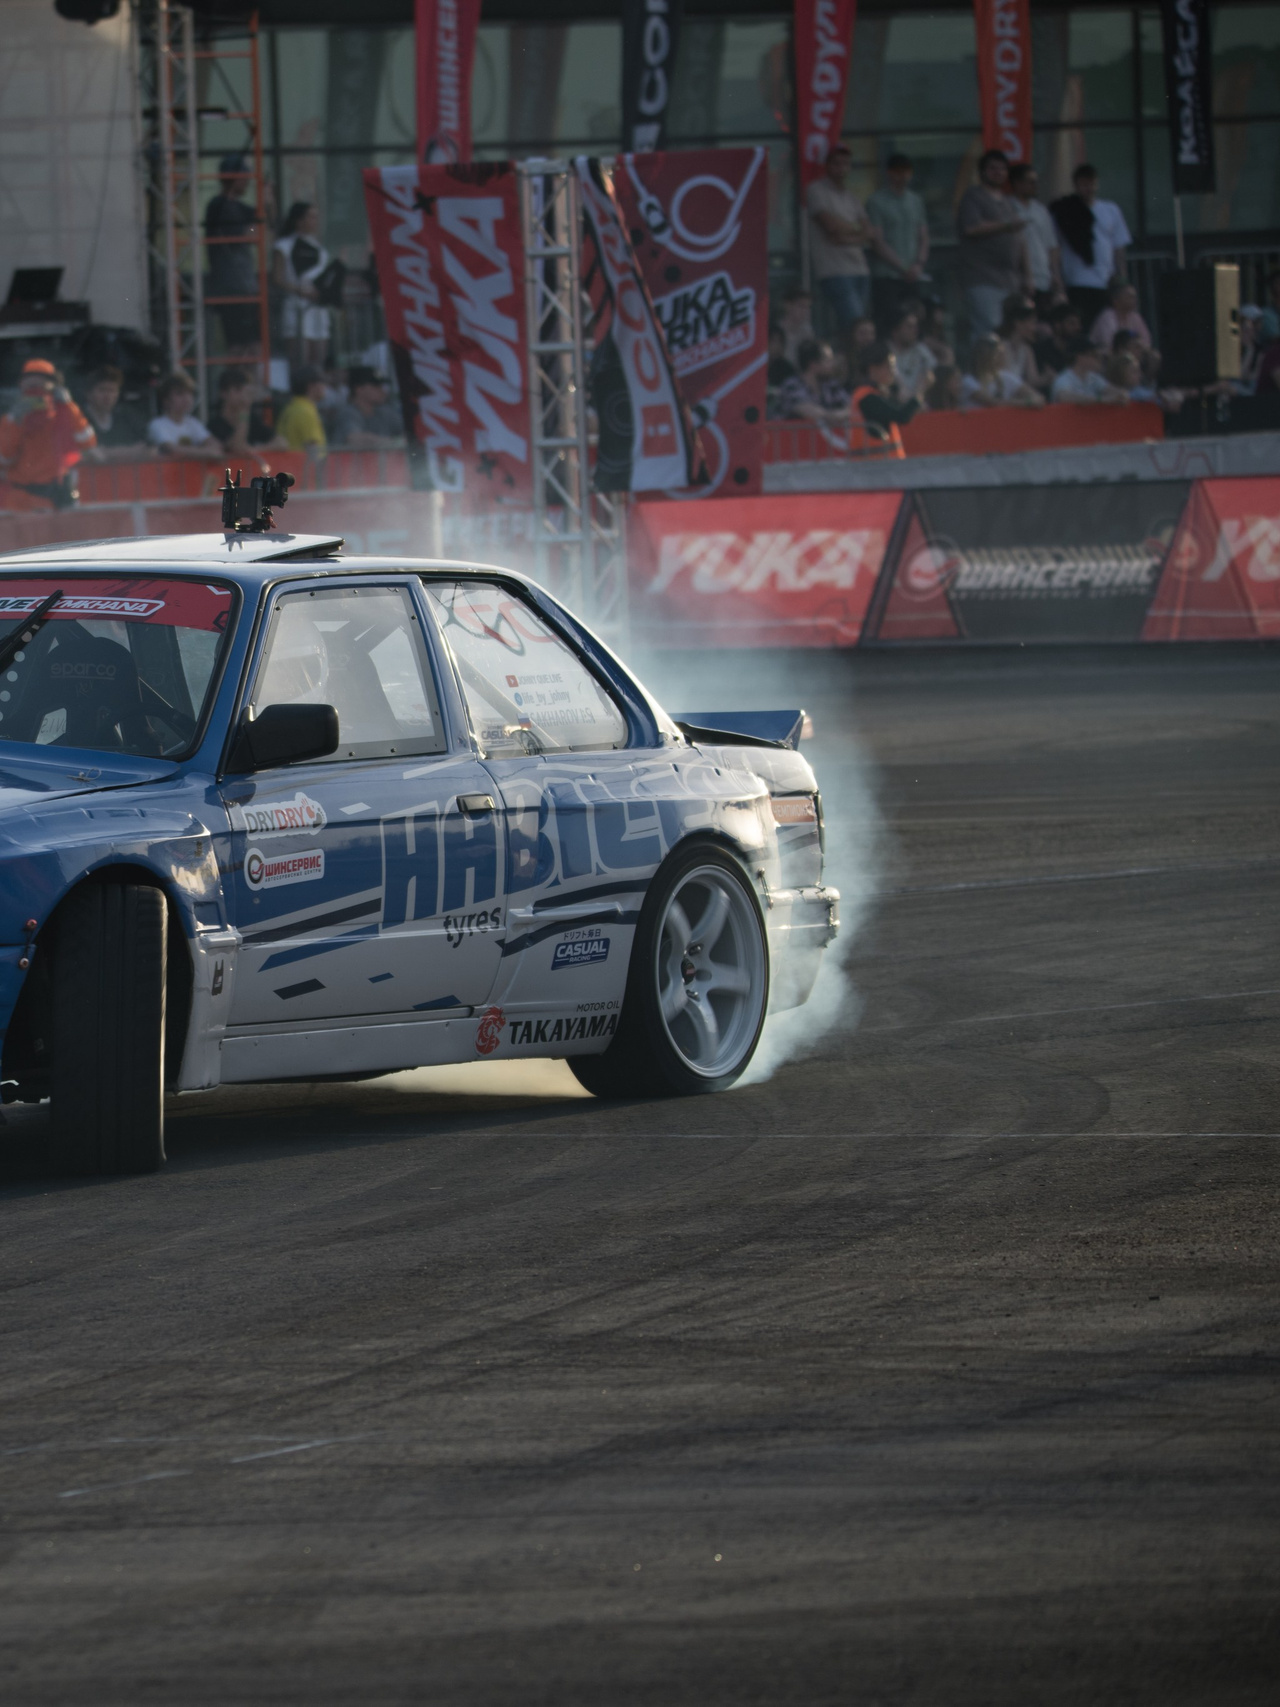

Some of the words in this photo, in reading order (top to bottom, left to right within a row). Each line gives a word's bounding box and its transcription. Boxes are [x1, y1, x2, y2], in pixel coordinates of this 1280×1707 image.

[653, 277, 733, 328] UKA
[381, 166, 465, 493] GYMKHANA
[437, 196, 528, 463] YUKA
[667, 295, 752, 355] RIVE
[648, 528, 883, 594] YUKA
[39, 599, 148, 613] YMKHANA
[245, 806, 305, 833] DRYDRY
[265, 855, 322, 877] ШИНСЕРВИС
[443, 905, 502, 949] tyres
[556, 940, 607, 958] CASUAL
[568, 955, 592, 963] RACING
[576, 1001, 605, 1012] MOTOR
[606, 1000, 620, 1010] OIL
[509, 1013, 618, 1045] TAKAYAMA
